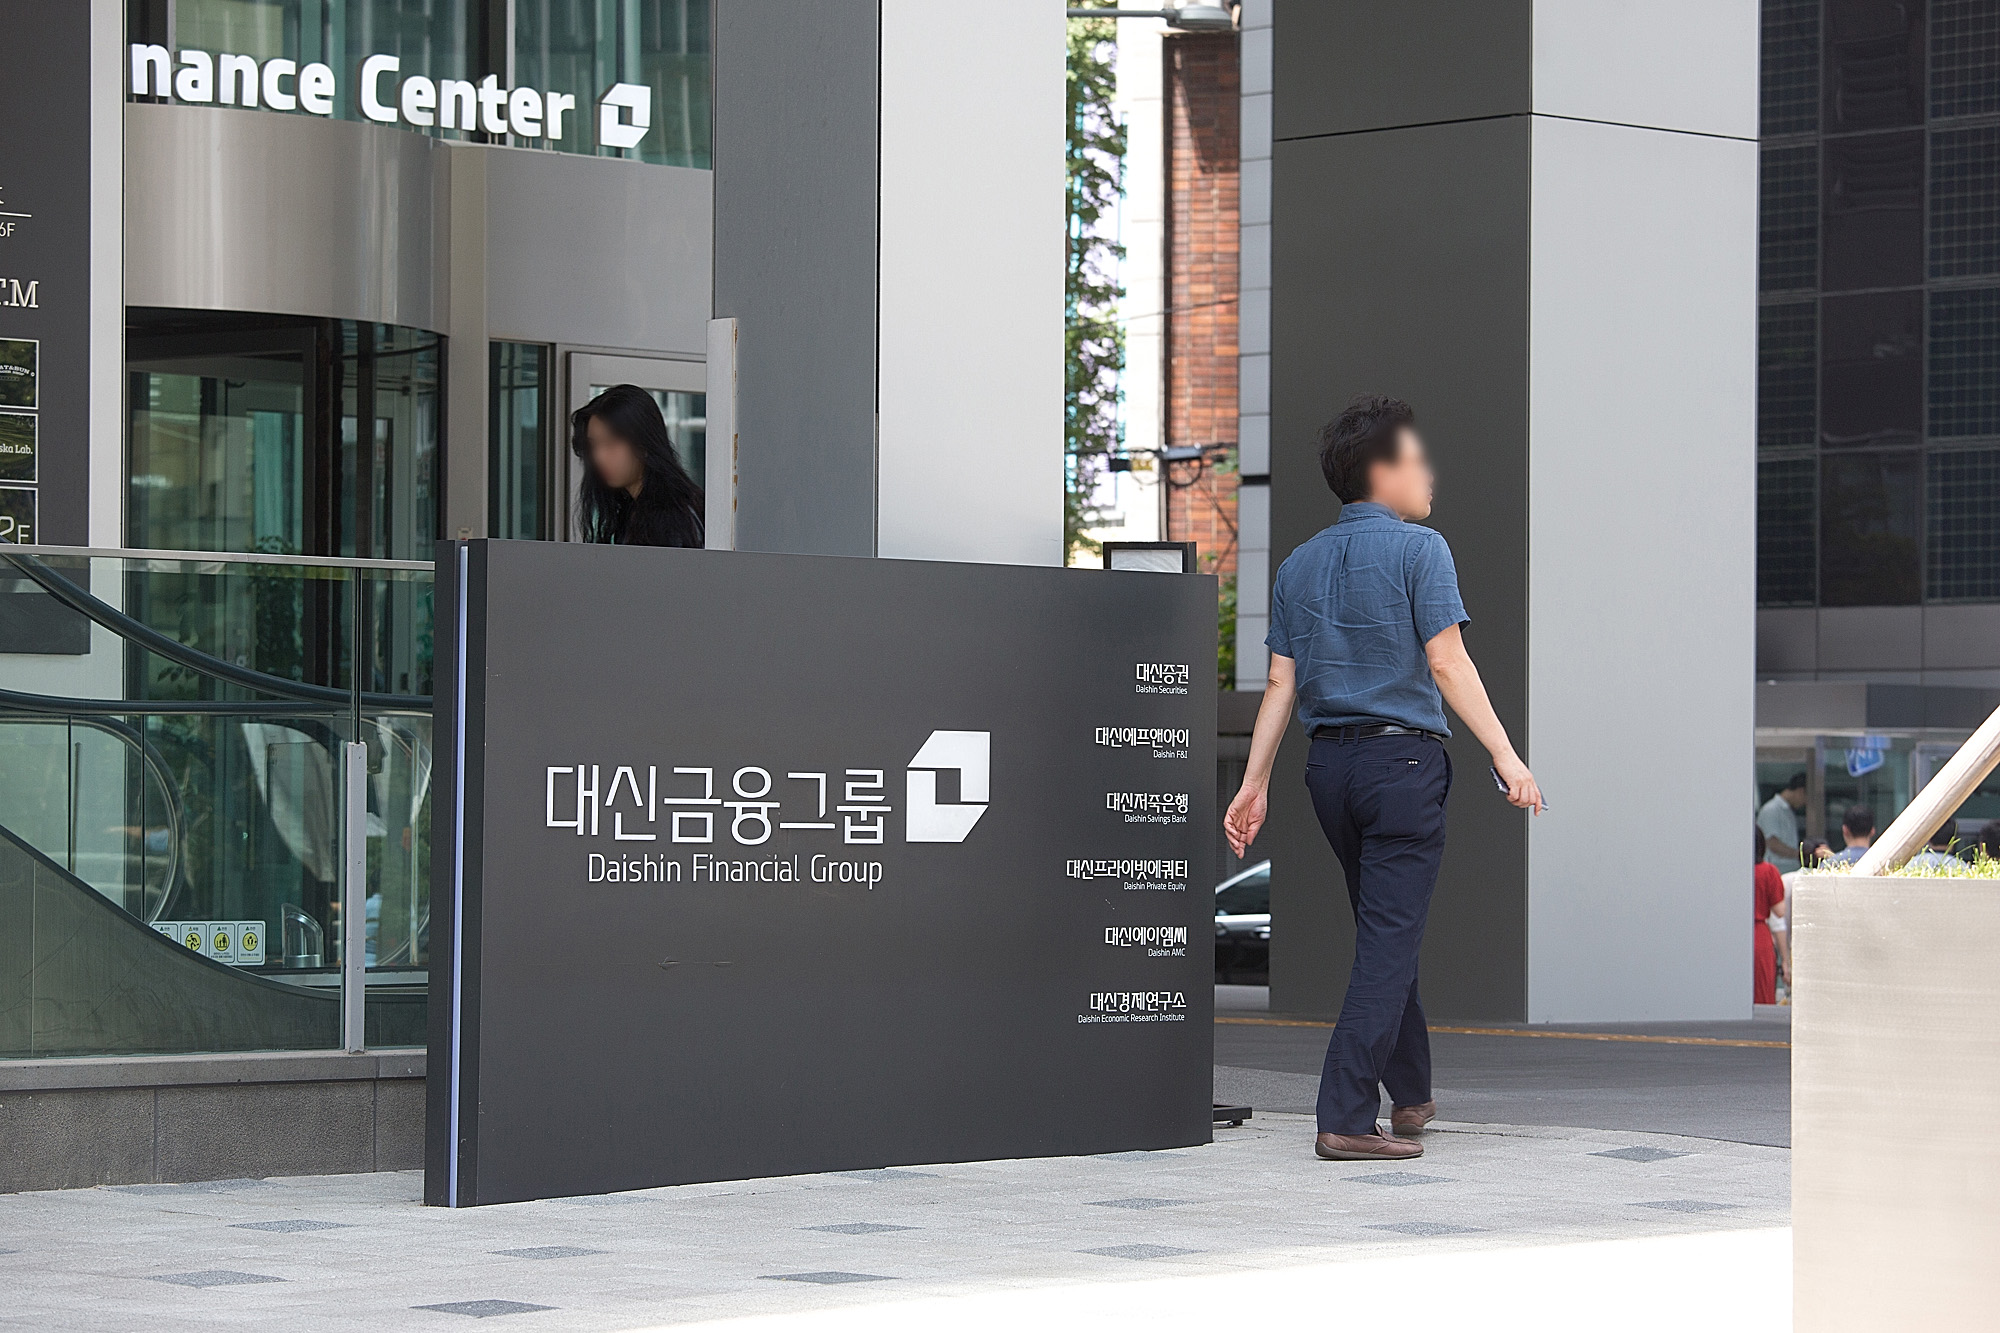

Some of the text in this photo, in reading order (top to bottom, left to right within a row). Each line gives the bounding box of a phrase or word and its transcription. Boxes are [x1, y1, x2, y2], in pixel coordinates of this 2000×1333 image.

[128, 43, 576, 140] nance Center
[15, 444, 33, 455] Lab.
[1136, 663, 1189, 685] 대신증권
[1135, 685, 1188, 695] Daishin Securities
[1095, 727, 1189, 748] 대신에프앤아이
[1153, 750, 1188, 759] Daishin F&I
[546, 764, 892, 846] 대신금융그룹
[1124, 814, 1187, 825] Daishin Savings Bank
[588, 853, 883, 890] Daishin Financial Group
[1066, 860, 1188, 880] 대신프라이빗에쿼티
[1123, 882, 1187, 892] Daishin Private Equity
[1104, 926, 1188, 947] 대신에이엠씨
[1147, 948, 1186, 957] Daishin AMC
[1089, 992, 1187, 1012] 대신경제연구소
[1077, 1012, 1185, 1023] Daishin Economic Research Institute
